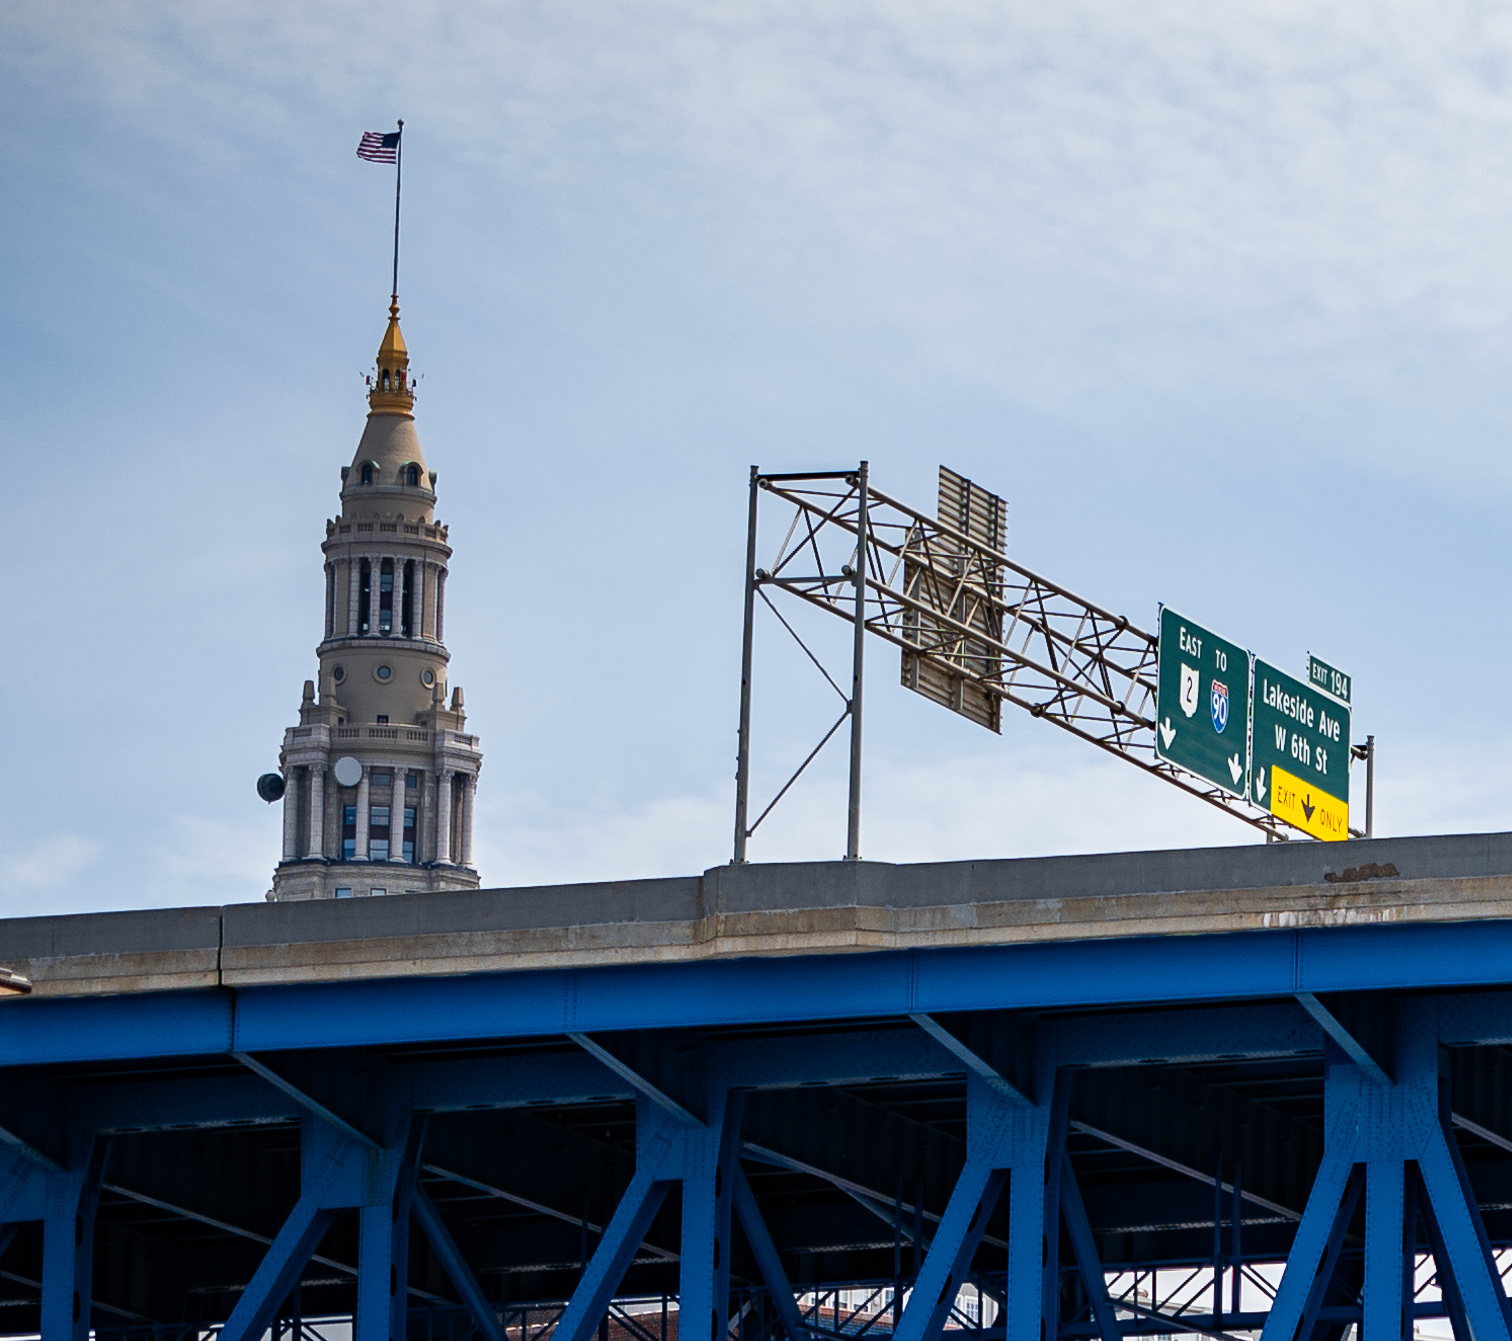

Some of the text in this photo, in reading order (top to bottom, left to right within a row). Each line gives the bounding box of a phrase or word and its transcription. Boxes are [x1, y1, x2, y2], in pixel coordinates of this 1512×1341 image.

[1178, 625, 1228, 673] EAST TO
[1186, 675, 1194, 704] 2
[1311, 662, 1349, 700] EXIT 194
[1212, 693, 1227, 725] 90
[1262, 678, 1342, 742] Lakeside Ave
[1274, 724, 1329, 775] W 6th St
[1277, 785, 1343, 835] EXIT ONLY
